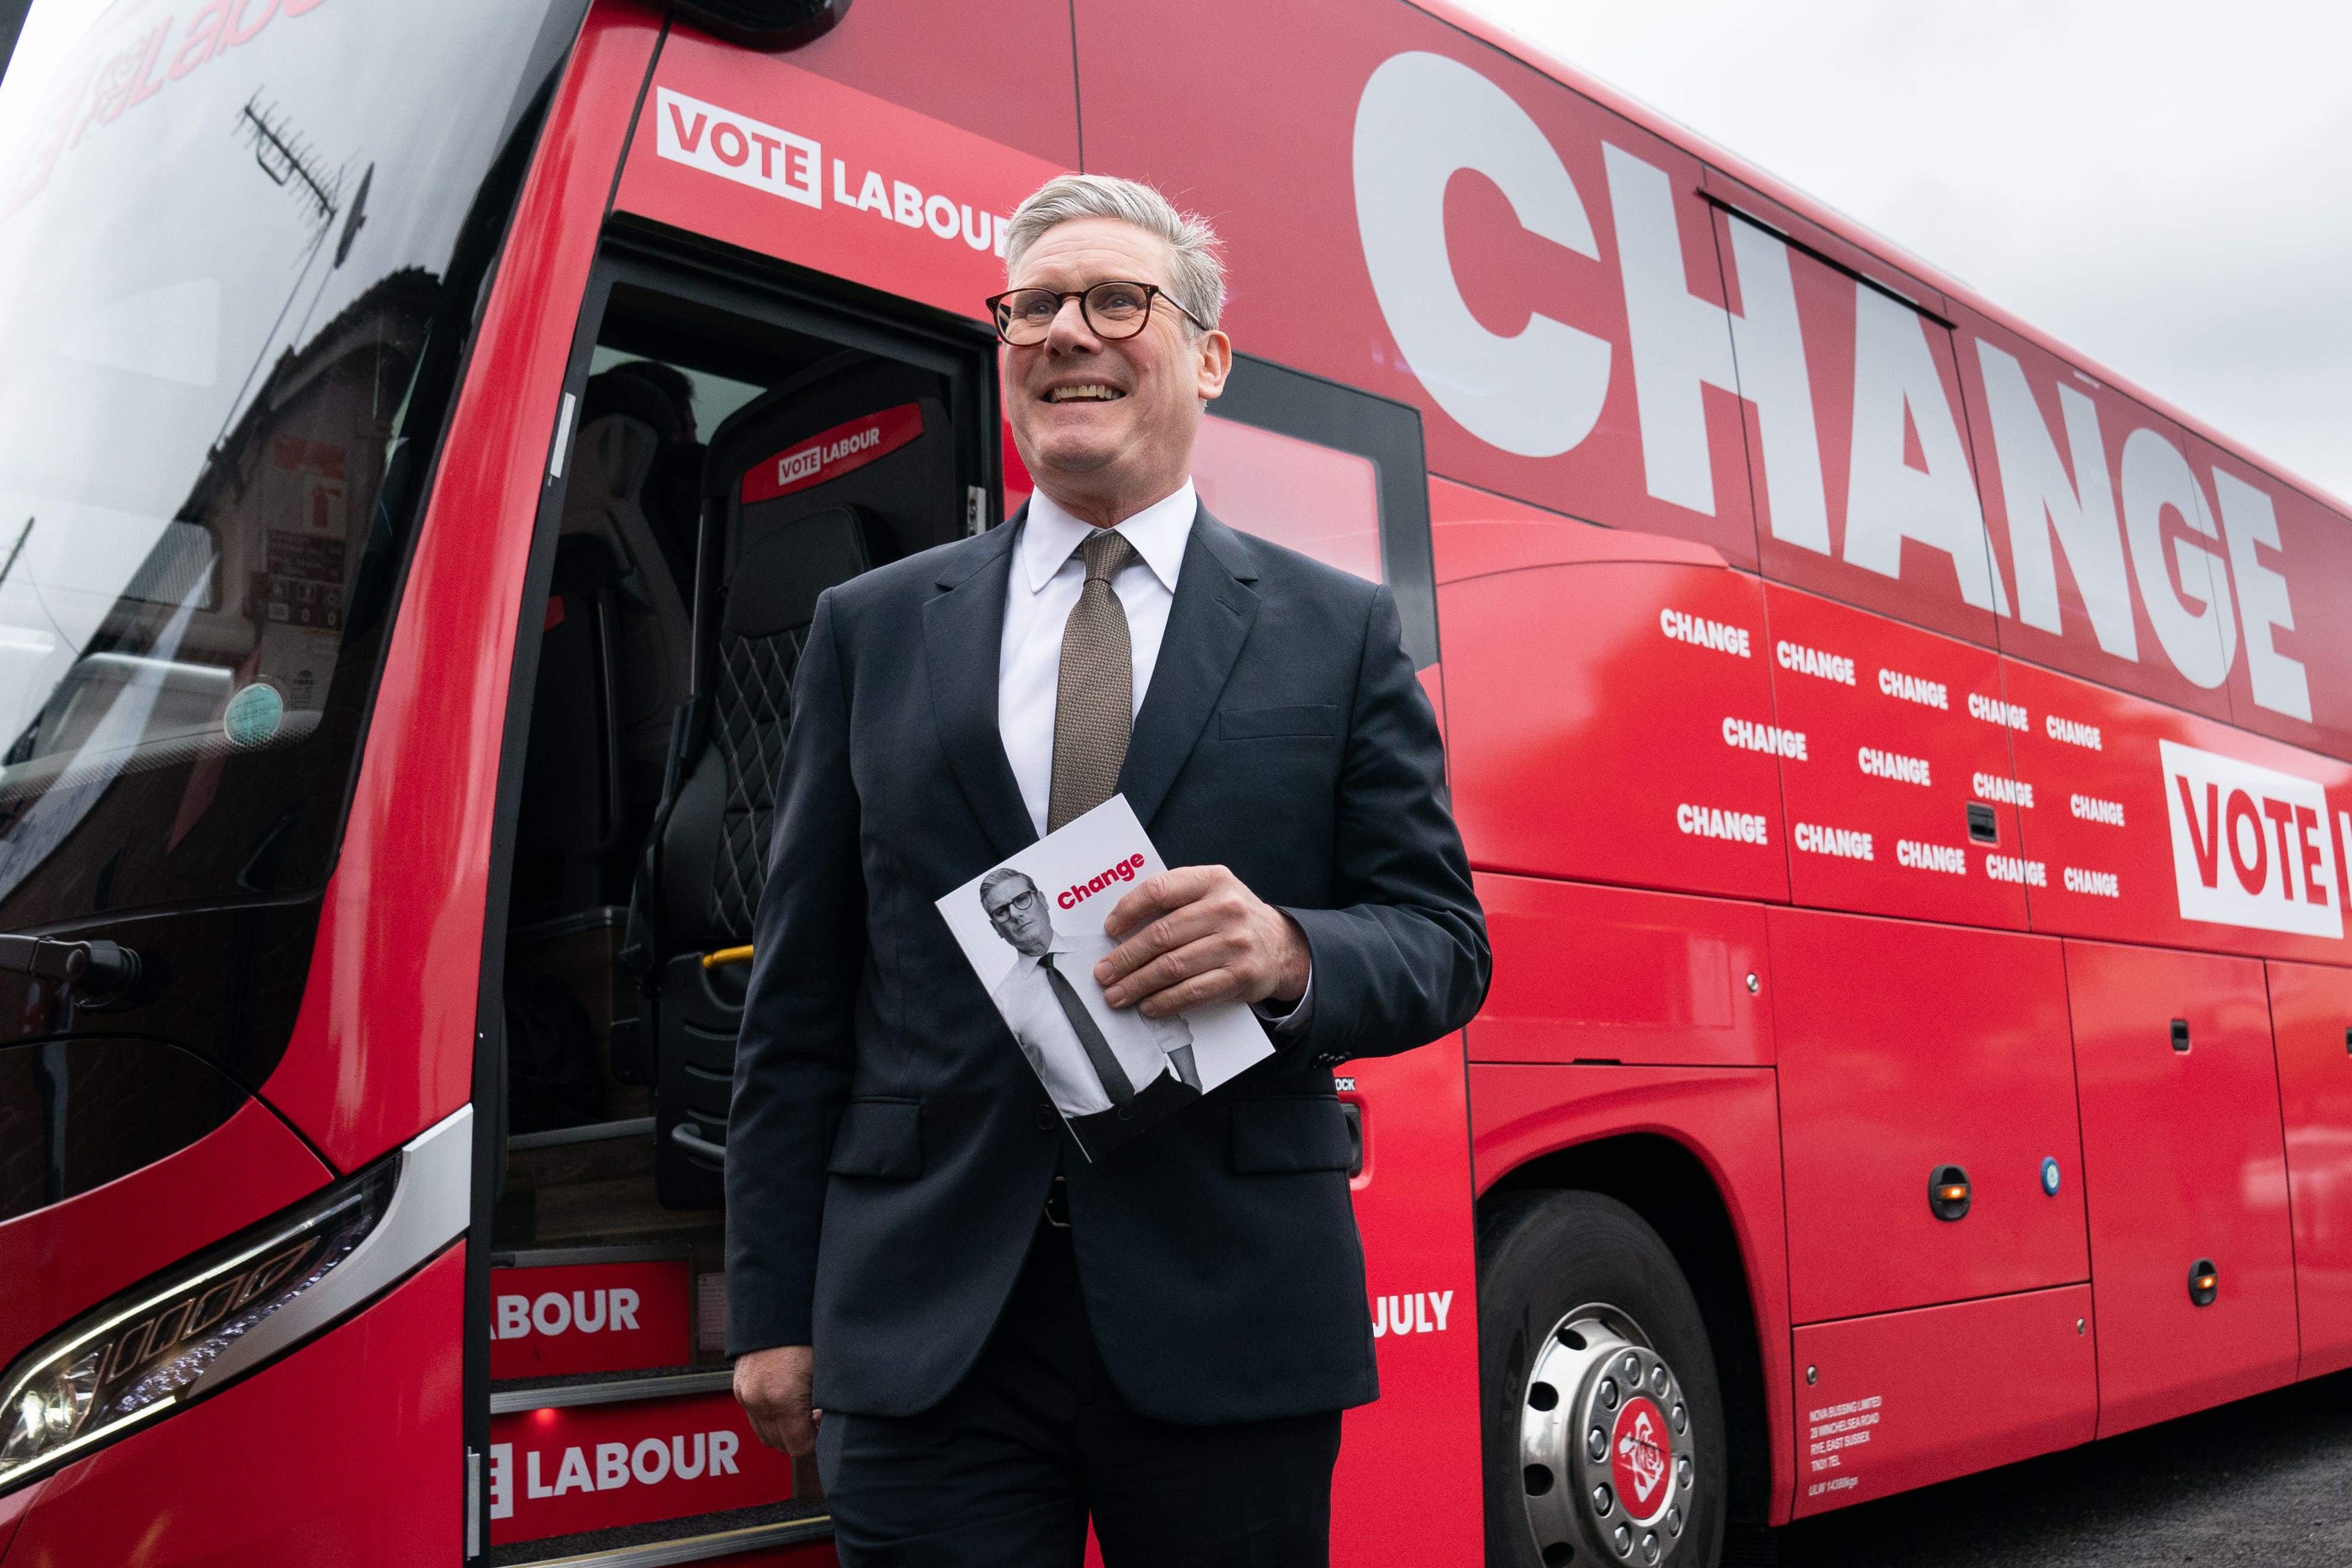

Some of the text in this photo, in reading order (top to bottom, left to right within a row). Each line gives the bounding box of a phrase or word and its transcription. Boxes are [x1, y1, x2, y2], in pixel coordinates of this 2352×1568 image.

[668, 102, 809, 193] VOTE
[1352, 50, 2312, 723] CHANGE
[782, 427, 880, 479] VOTE LABOUR
[1660, 608, 2102, 750] CHANGE CHANGE CHANGE CHANGE CHANGE
[1723, 717, 2124, 826] CHANGE CHANGE CHANGE CHANGE
[1677, 804, 2119, 898] CHANGE CHANGE CHANGE CHANGE CHANGE
[2175, 774, 2328, 907] VOTE
[1057, 853, 1145, 910] Change
[490, 1288, 640, 1340] BOUR
[1372, 1290, 1454, 1338] JULY
[1809, 1408, 1828, 1423] NOVA
[1858, 1395, 1882, 1411] LIMITED
[1818, 1416, 1860, 1437] WINCHELSEA
[1860, 1412, 1880, 1428] ROAD
[1826, 1437, 1844, 1451] EAST
[1844, 1430, 1870, 1447] SUSSEX
[527, 1430, 740, 1499] LABOUR
